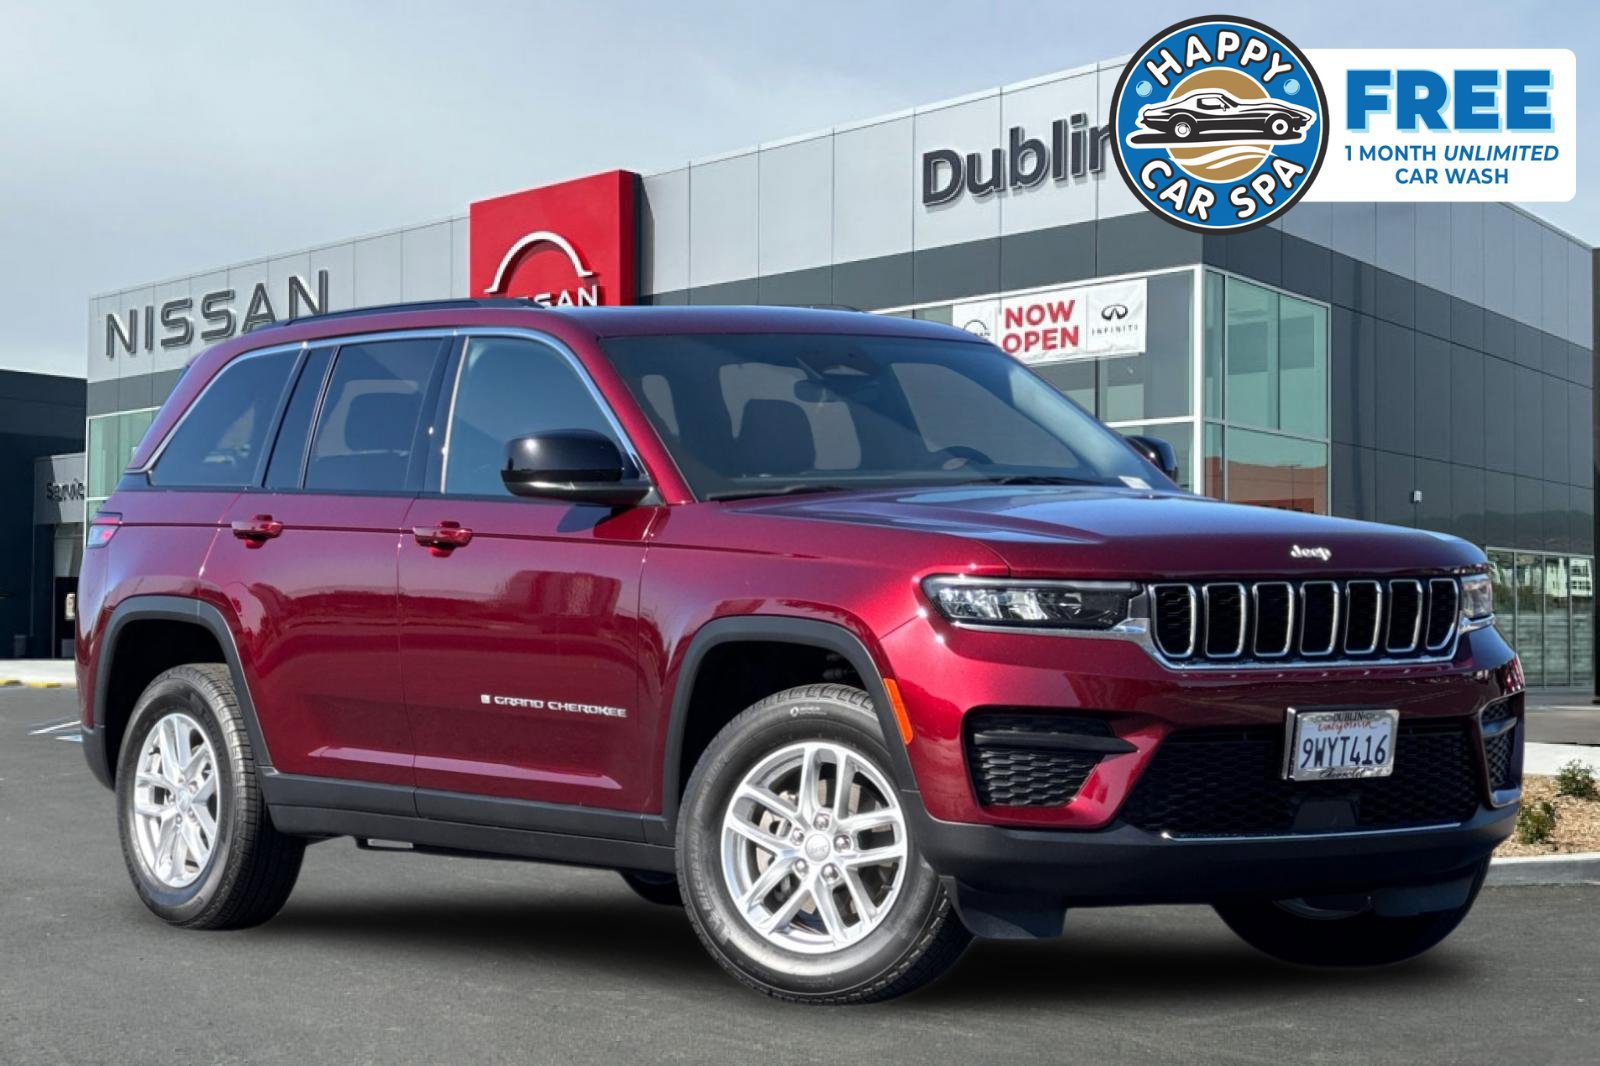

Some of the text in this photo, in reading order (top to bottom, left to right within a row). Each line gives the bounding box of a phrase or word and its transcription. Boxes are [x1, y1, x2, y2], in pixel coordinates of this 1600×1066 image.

[106, 269, 328, 359] NISSAN
[1005, 300, 1076, 329] NOW
[1002, 325, 1079, 353] OPEN
[1092, 324, 1138, 335] INFINITI
[46, 478, 84, 502] Servic
[1290, 544, 1332, 561] Jeep
[494, 695, 627, 718] GRAND CHEROKEE
[1333, 711, 1364, 721] DUBLIN
[1301, 735, 1388, 769] 9WYT416
